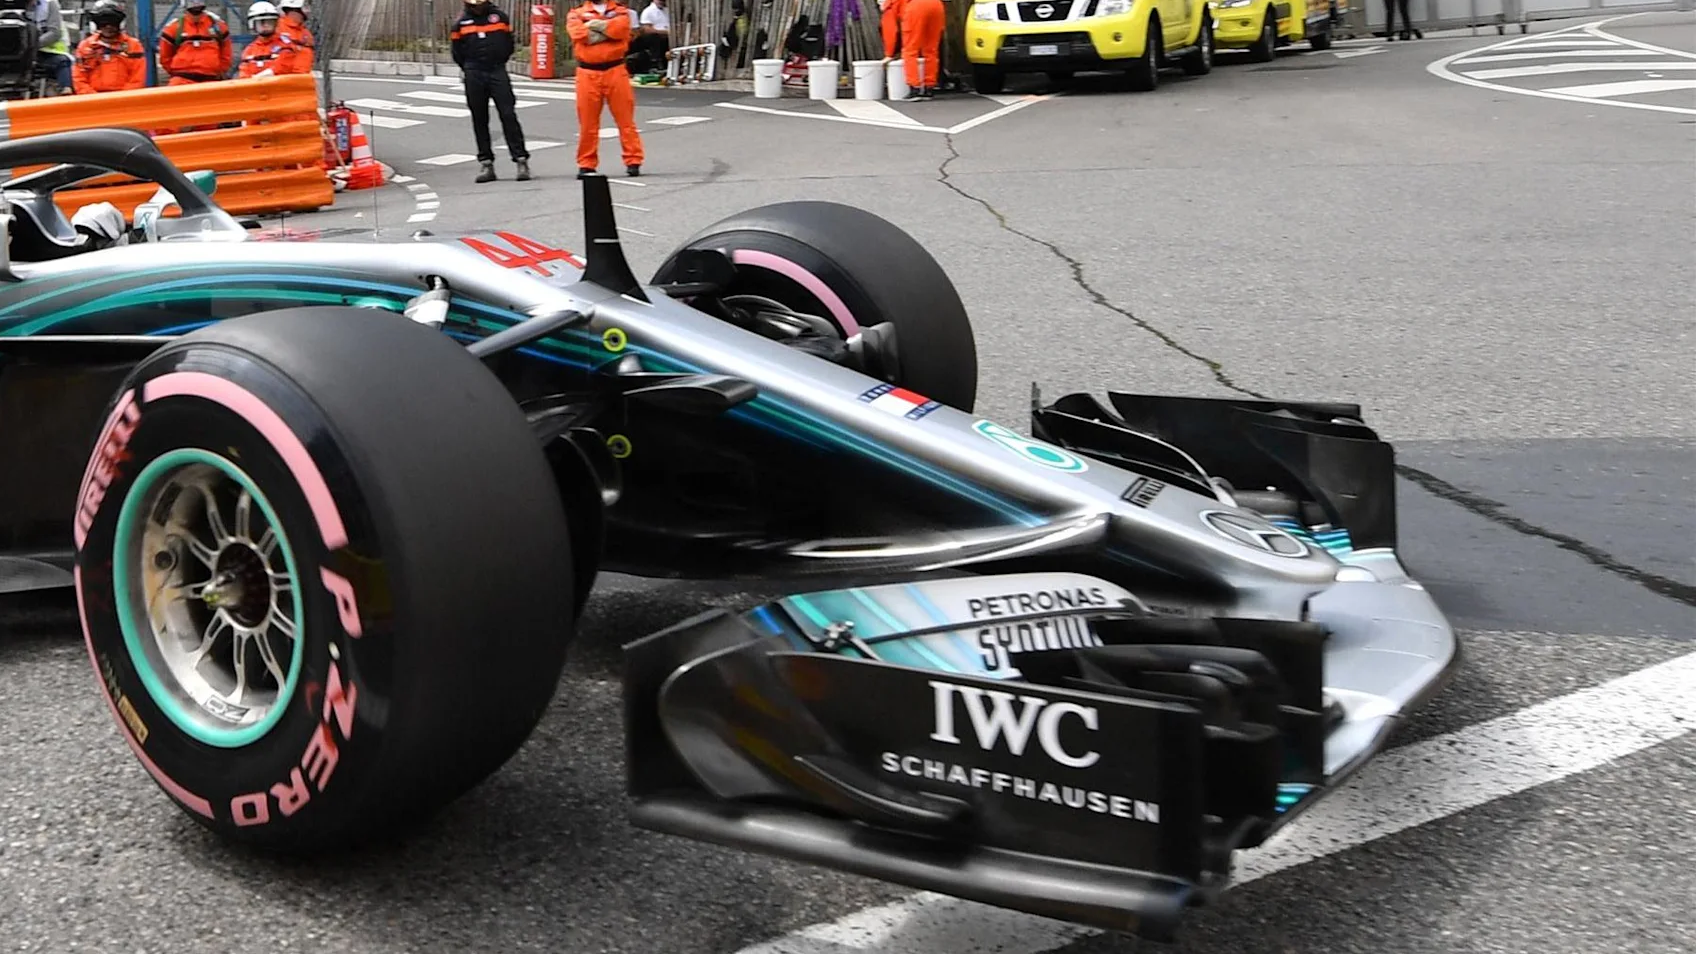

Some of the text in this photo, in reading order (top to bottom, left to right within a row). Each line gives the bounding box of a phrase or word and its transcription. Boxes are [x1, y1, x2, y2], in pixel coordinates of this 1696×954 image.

[458, 230, 587, 277] 44
[968, 588, 1107, 619] PETRONAS
[230, 566, 363, 827] P ZERO
[928, 680, 1101, 769] IWC
[881, 751, 1161, 824] SCHAFFHAUSEN
